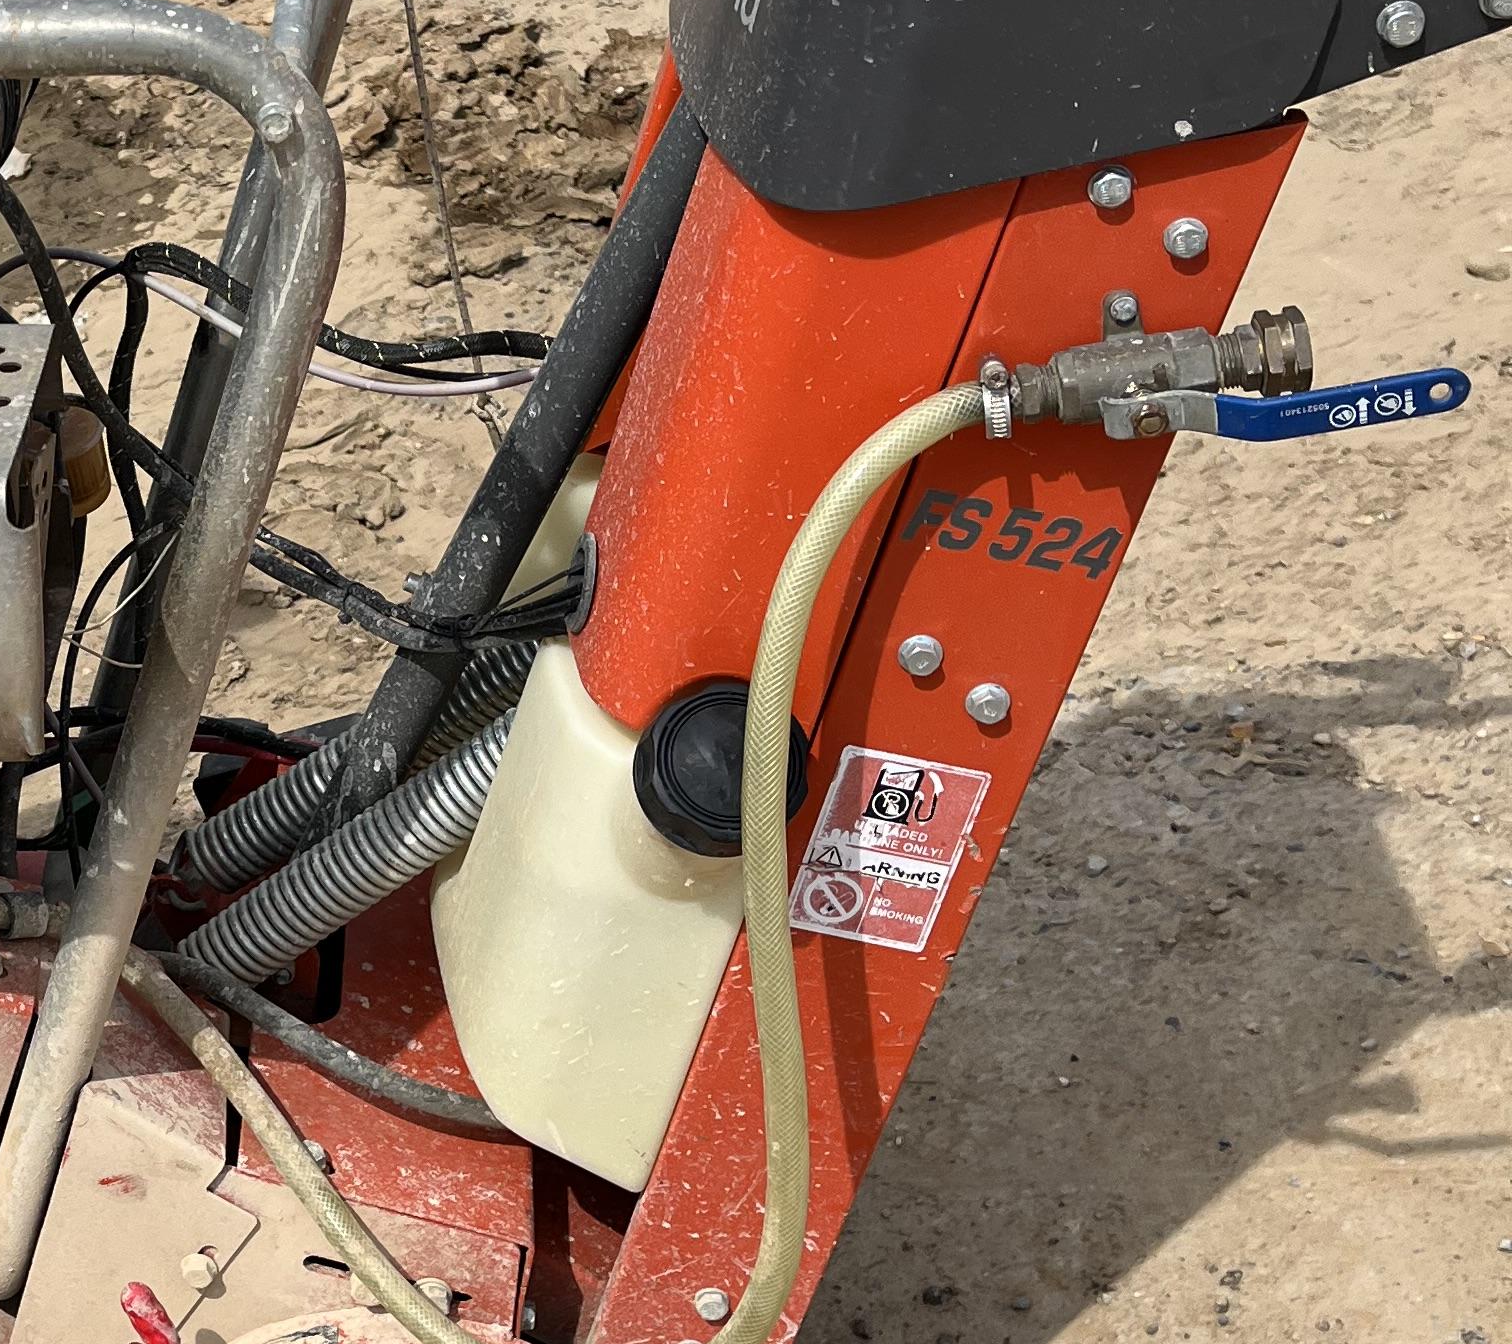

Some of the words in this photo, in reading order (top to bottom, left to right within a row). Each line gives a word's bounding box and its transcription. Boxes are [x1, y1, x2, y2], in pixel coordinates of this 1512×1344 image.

[900, 488, 993, 551] FS
[988, 507, 1124, 580] 524
[903, 842, 944, 859] ONLY!
[873, 896, 892, 908] NO
[869, 908, 924, 926] SMOKING
